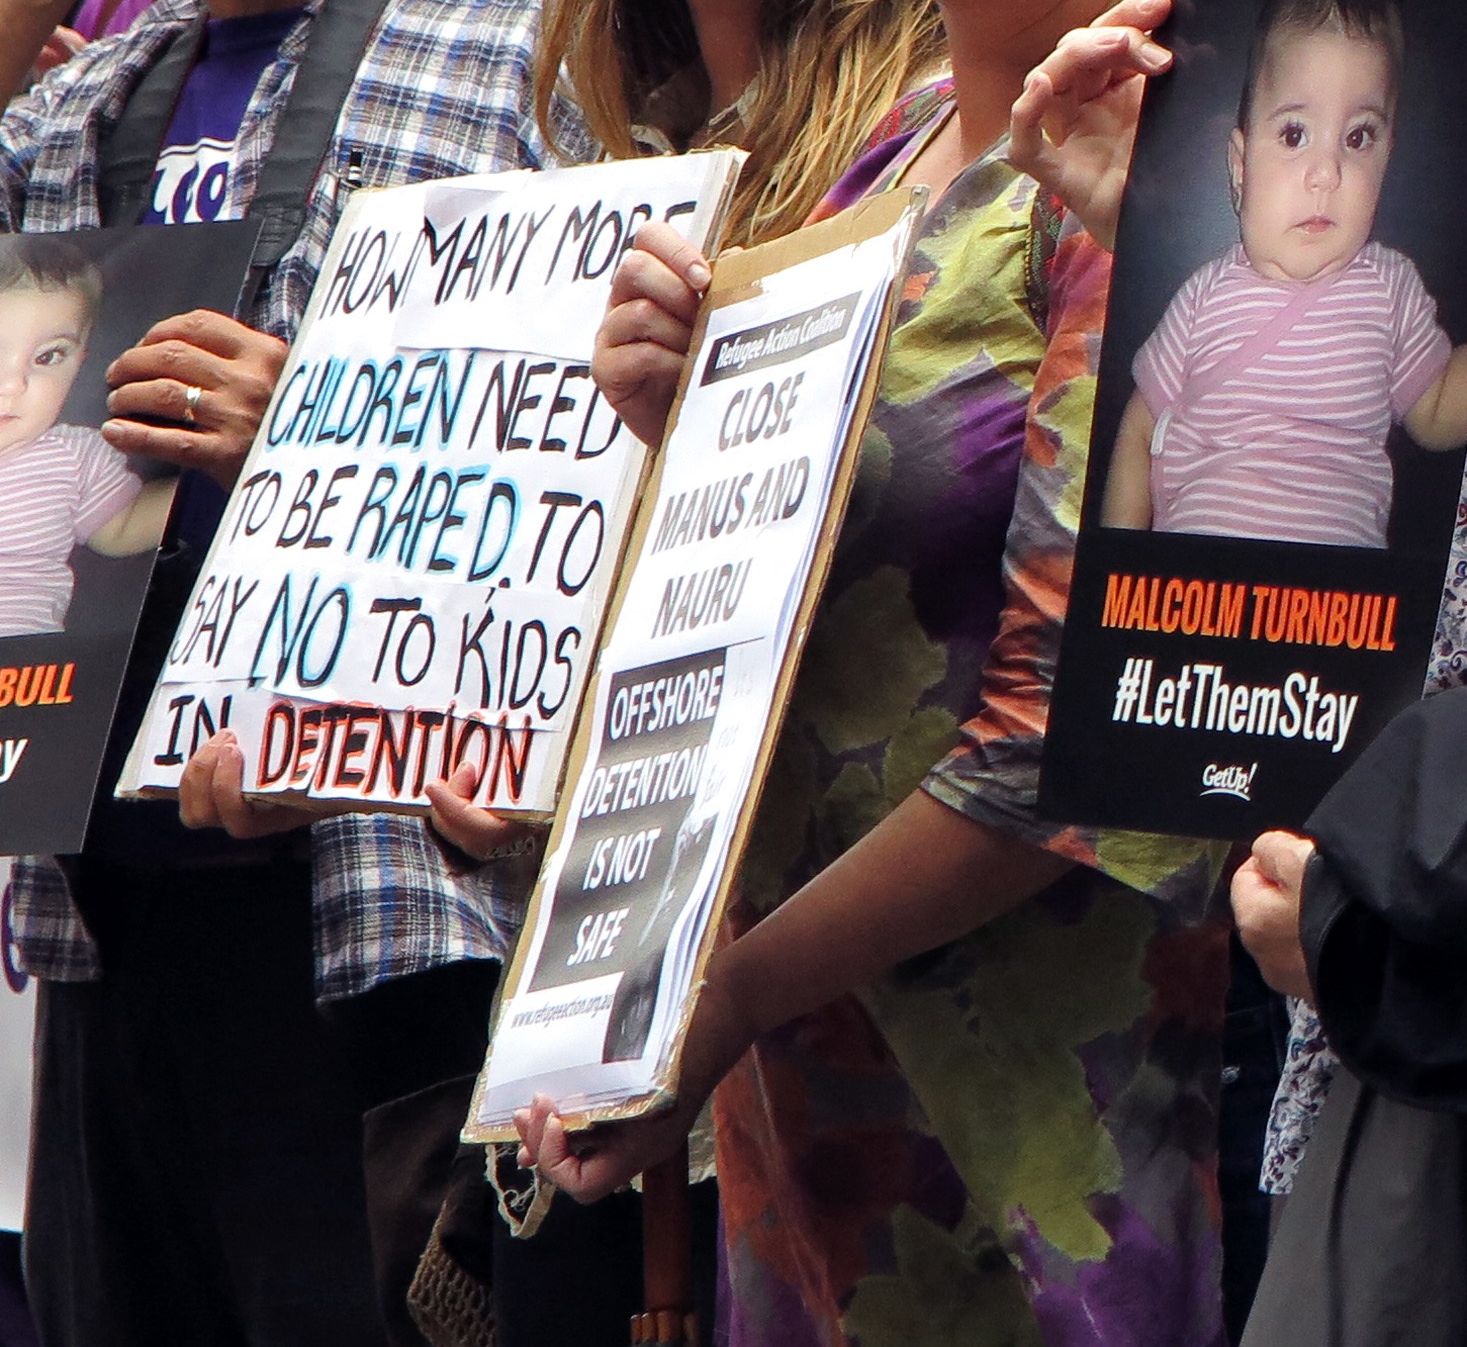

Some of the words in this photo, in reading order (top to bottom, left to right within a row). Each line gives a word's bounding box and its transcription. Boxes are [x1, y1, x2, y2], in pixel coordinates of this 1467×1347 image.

[319, 226, 415, 320] HOW
[402, 205, 556, 306] MANY
[715, 337, 764, 370] Refugee
[764, 323, 801, 355] Action
[267, 350, 476, 452] CHILDREN
[468, 357, 624, 460] NEED
[718, 371, 805, 453] CLOSE
[230, 469, 283, 545] TO
[275, 465, 358, 549] BE
[526, 491, 605, 597] TO
[651, 470, 753, 556] MANUS
[745, 455, 811, 528] AND
[651, 557, 754, 639] NAURU
[1101, 574, 1246, 639] MALCOLM
[1250, 586, 1398, 652] TURNBULL
[169, 575, 260, 669] SAY
[247, 572, 351, 690] NO
[368, 598, 436, 685] TO
[454, 604, 582, 721] KIDS
[610, 665, 724, 741] OFFSHORE
[1111, 657, 1359, 754] #LetThemStay
[154, 695, 232, 767] IN
[256, 700, 535, 807] DETENTION
[582, 744, 708, 819] DETENTION
[1201, 762, 1258, 794] GetUp!
[583, 837, 614, 891] IS
[605, 828, 661, 886] NOT
[566, 907, 630, 966] SAFE
